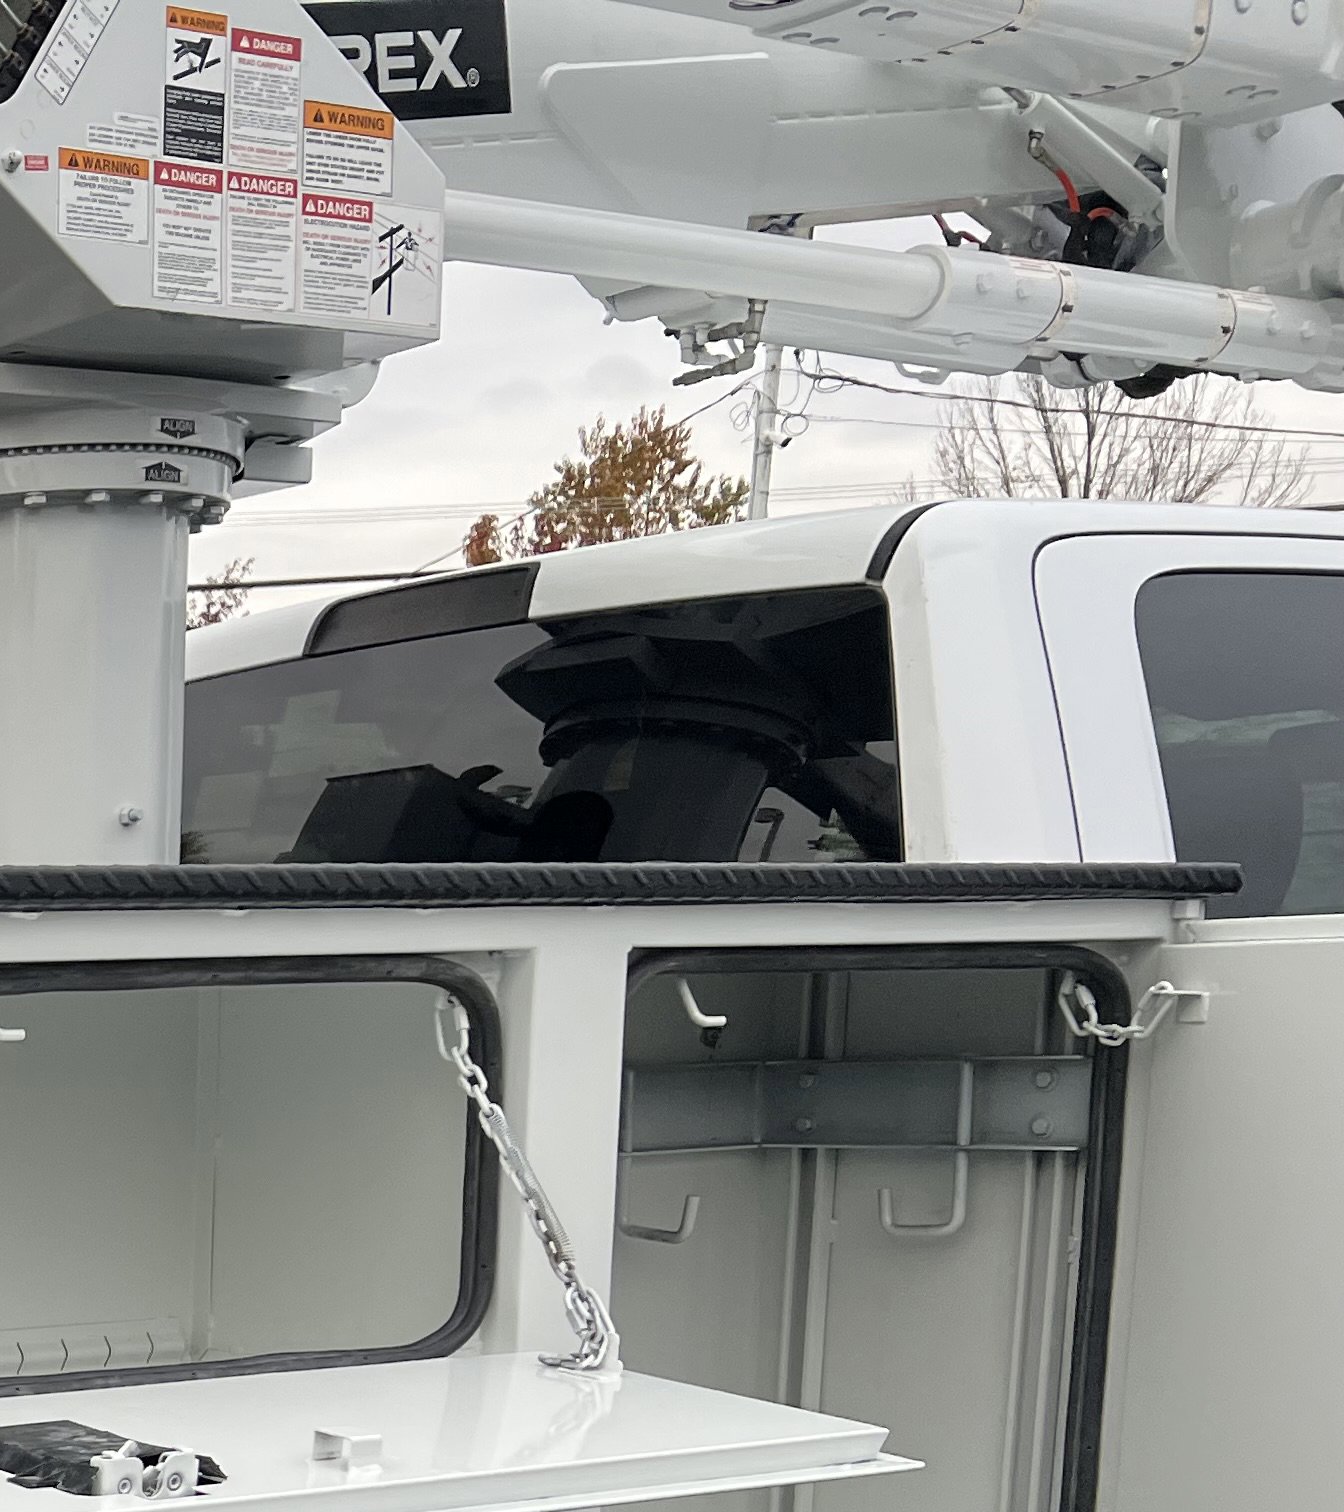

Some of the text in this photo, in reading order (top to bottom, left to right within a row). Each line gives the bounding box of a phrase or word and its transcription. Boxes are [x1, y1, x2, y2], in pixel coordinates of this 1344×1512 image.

[180, 15, 226, 32] WARNING
[253, 38, 294, 54] DANGER
[327, 110, 385, 131] WARNING
[82, 156, 140, 176] WARNING
[171, 169, 217, 187] DANGER
[241, 176, 294, 195] DANGER
[317, 200, 370, 219] DANGER
[163, 419, 193, 432] ALIGN
[148, 469, 179, 481] ALIGN
